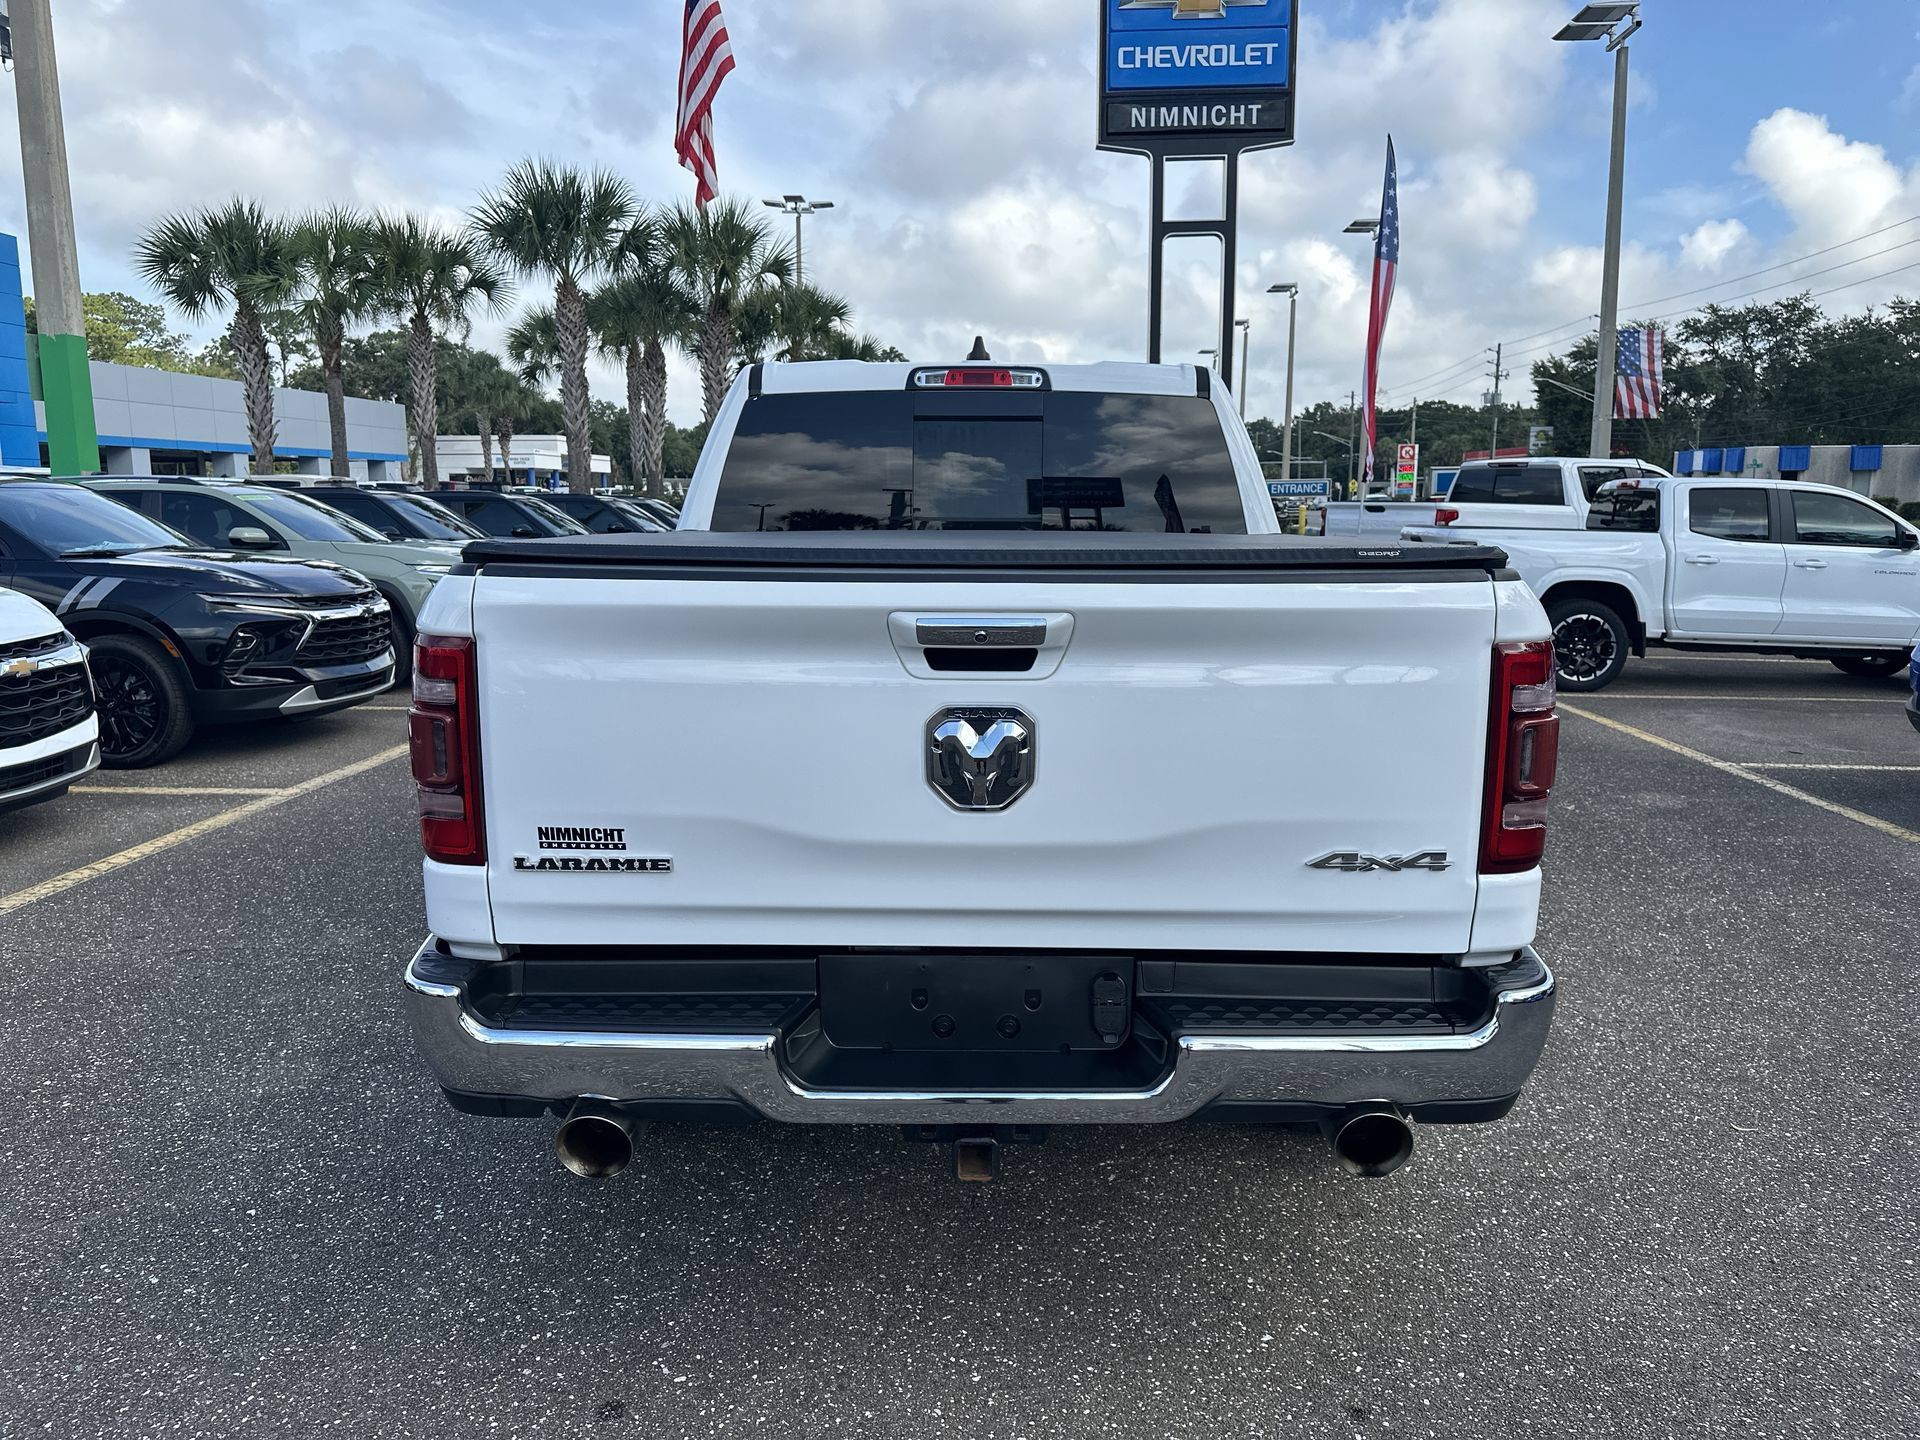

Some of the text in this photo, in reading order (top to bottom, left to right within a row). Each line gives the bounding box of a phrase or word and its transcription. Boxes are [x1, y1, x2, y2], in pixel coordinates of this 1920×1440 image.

[1117, 43, 1279, 69] CHEVROLET
[1130, 104, 1262, 128] NIMNICHT
[1271, 483, 1324, 494] ENTRANCE
[537, 826, 625, 843] NIMNICHT
[541, 842, 624, 850] CHEVROLET
[512, 855, 674, 873] LARAMIE
